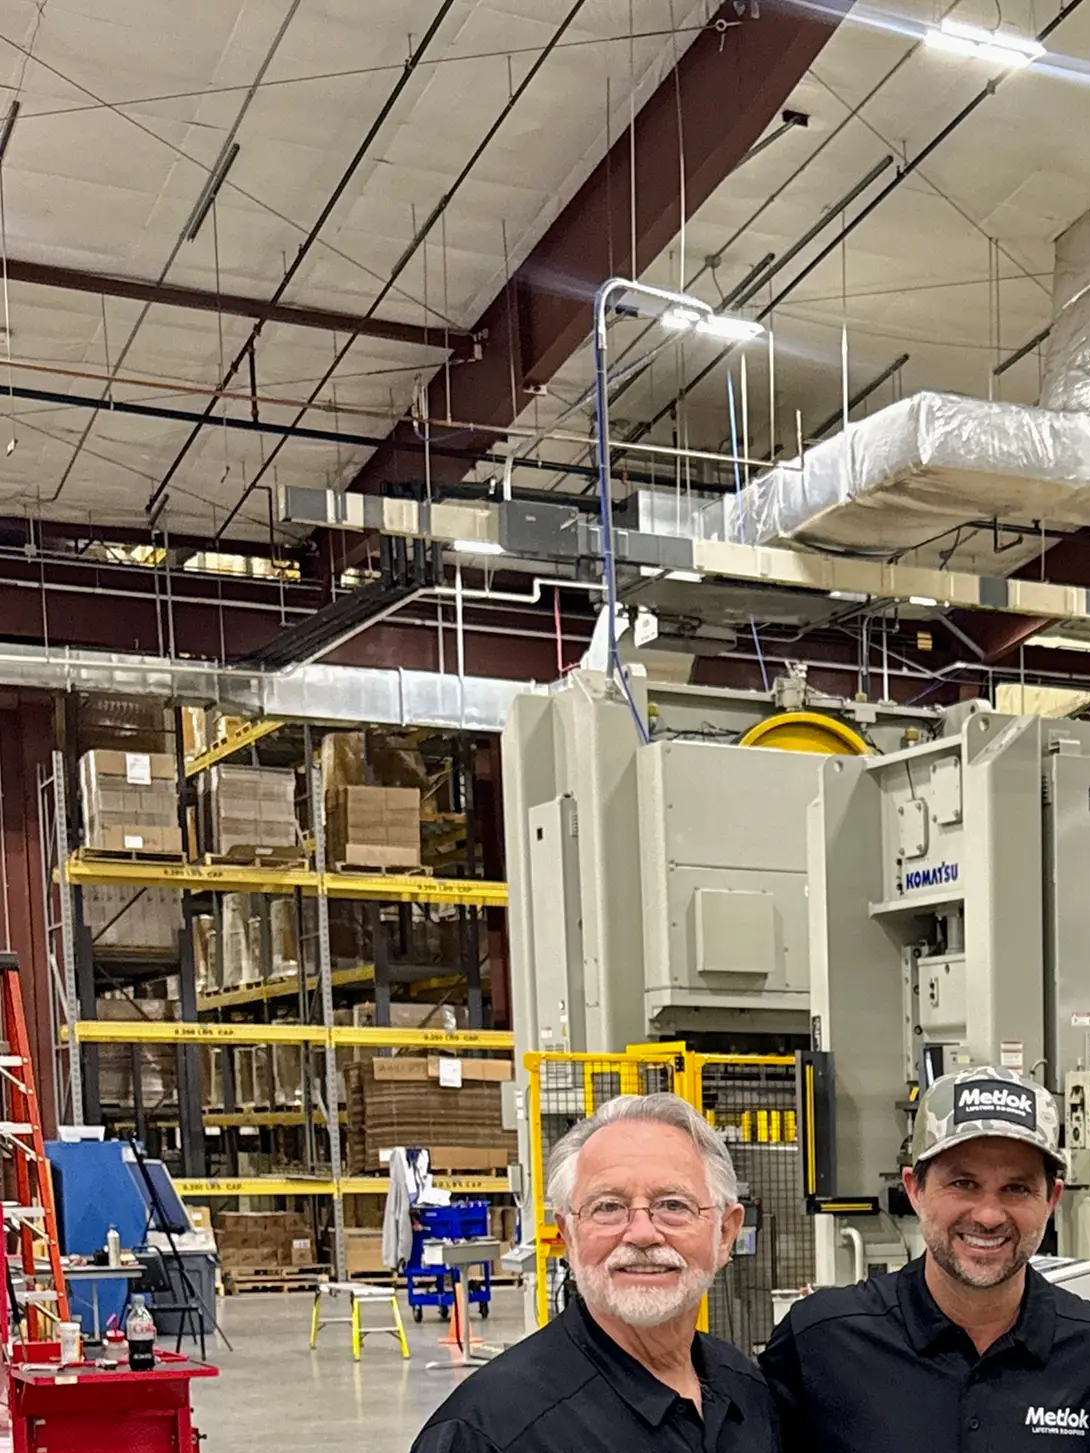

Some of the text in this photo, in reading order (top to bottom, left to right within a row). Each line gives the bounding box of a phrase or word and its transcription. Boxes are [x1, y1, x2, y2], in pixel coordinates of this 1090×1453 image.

[905, 861, 959, 890] KOMATSU
[958, 1088, 1033, 1113] Metlok
[1025, 1406, 1089, 1429] Metlok
